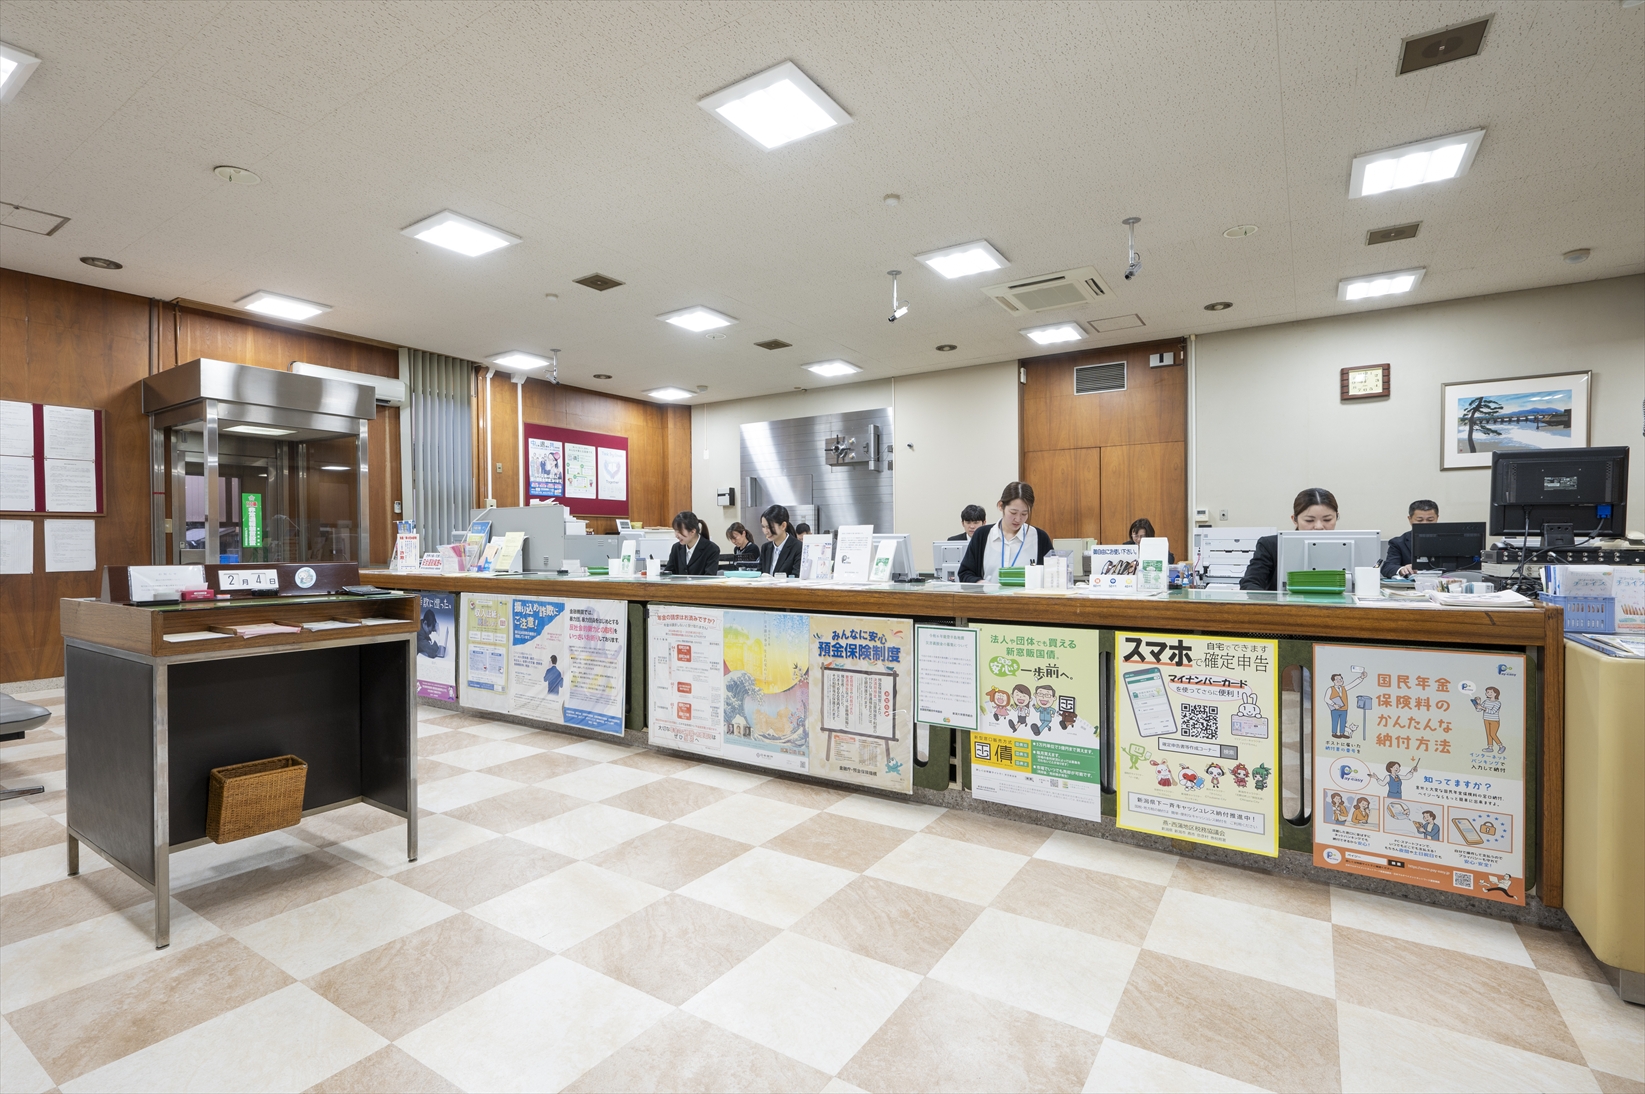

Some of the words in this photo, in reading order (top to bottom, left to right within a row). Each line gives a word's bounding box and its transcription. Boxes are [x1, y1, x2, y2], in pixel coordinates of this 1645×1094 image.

[228, 574, 235, 585] 2
[256, 575, 262, 585] 4
[514, 601, 558, 617] 振り込め詐欺に
[569, 624, 617, 634] 反社会的勢力との取引を
[832, 629, 887, 645] みんなに安心
[990, 634, 1077, 649] 法人や団体でも買える
[818, 641, 901, 663] 預金保険制度
[1006, 647, 1059, 660] 新窓販国債。
[1123, 637, 1269, 672] スマホで確定申告
[1207, 642, 1268, 653] 自宅でできます
[1020, 663, 1073, 681] 一歩前へ。
[1168, 674, 1248, 688] マイナンバーカード
[1377, 674, 1451, 693] 国民年金
[1176, 686, 1240, 698] を使ってさらに便利！
[1376, 693, 1451, 712] 保険料の
[1377, 714, 1452, 733] かんたんな
[1162, 741, 1217, 752] 確定申告書等作成コーナー
[1376, 733, 1451, 754] 納付方法
[1471, 765, 1505, 773] 入力して納付
[1424, 776, 1492, 791] 知ってますか？
[1137, 796, 1256, 822] 新潟県下一斉キャッシュレス納付推進中！
